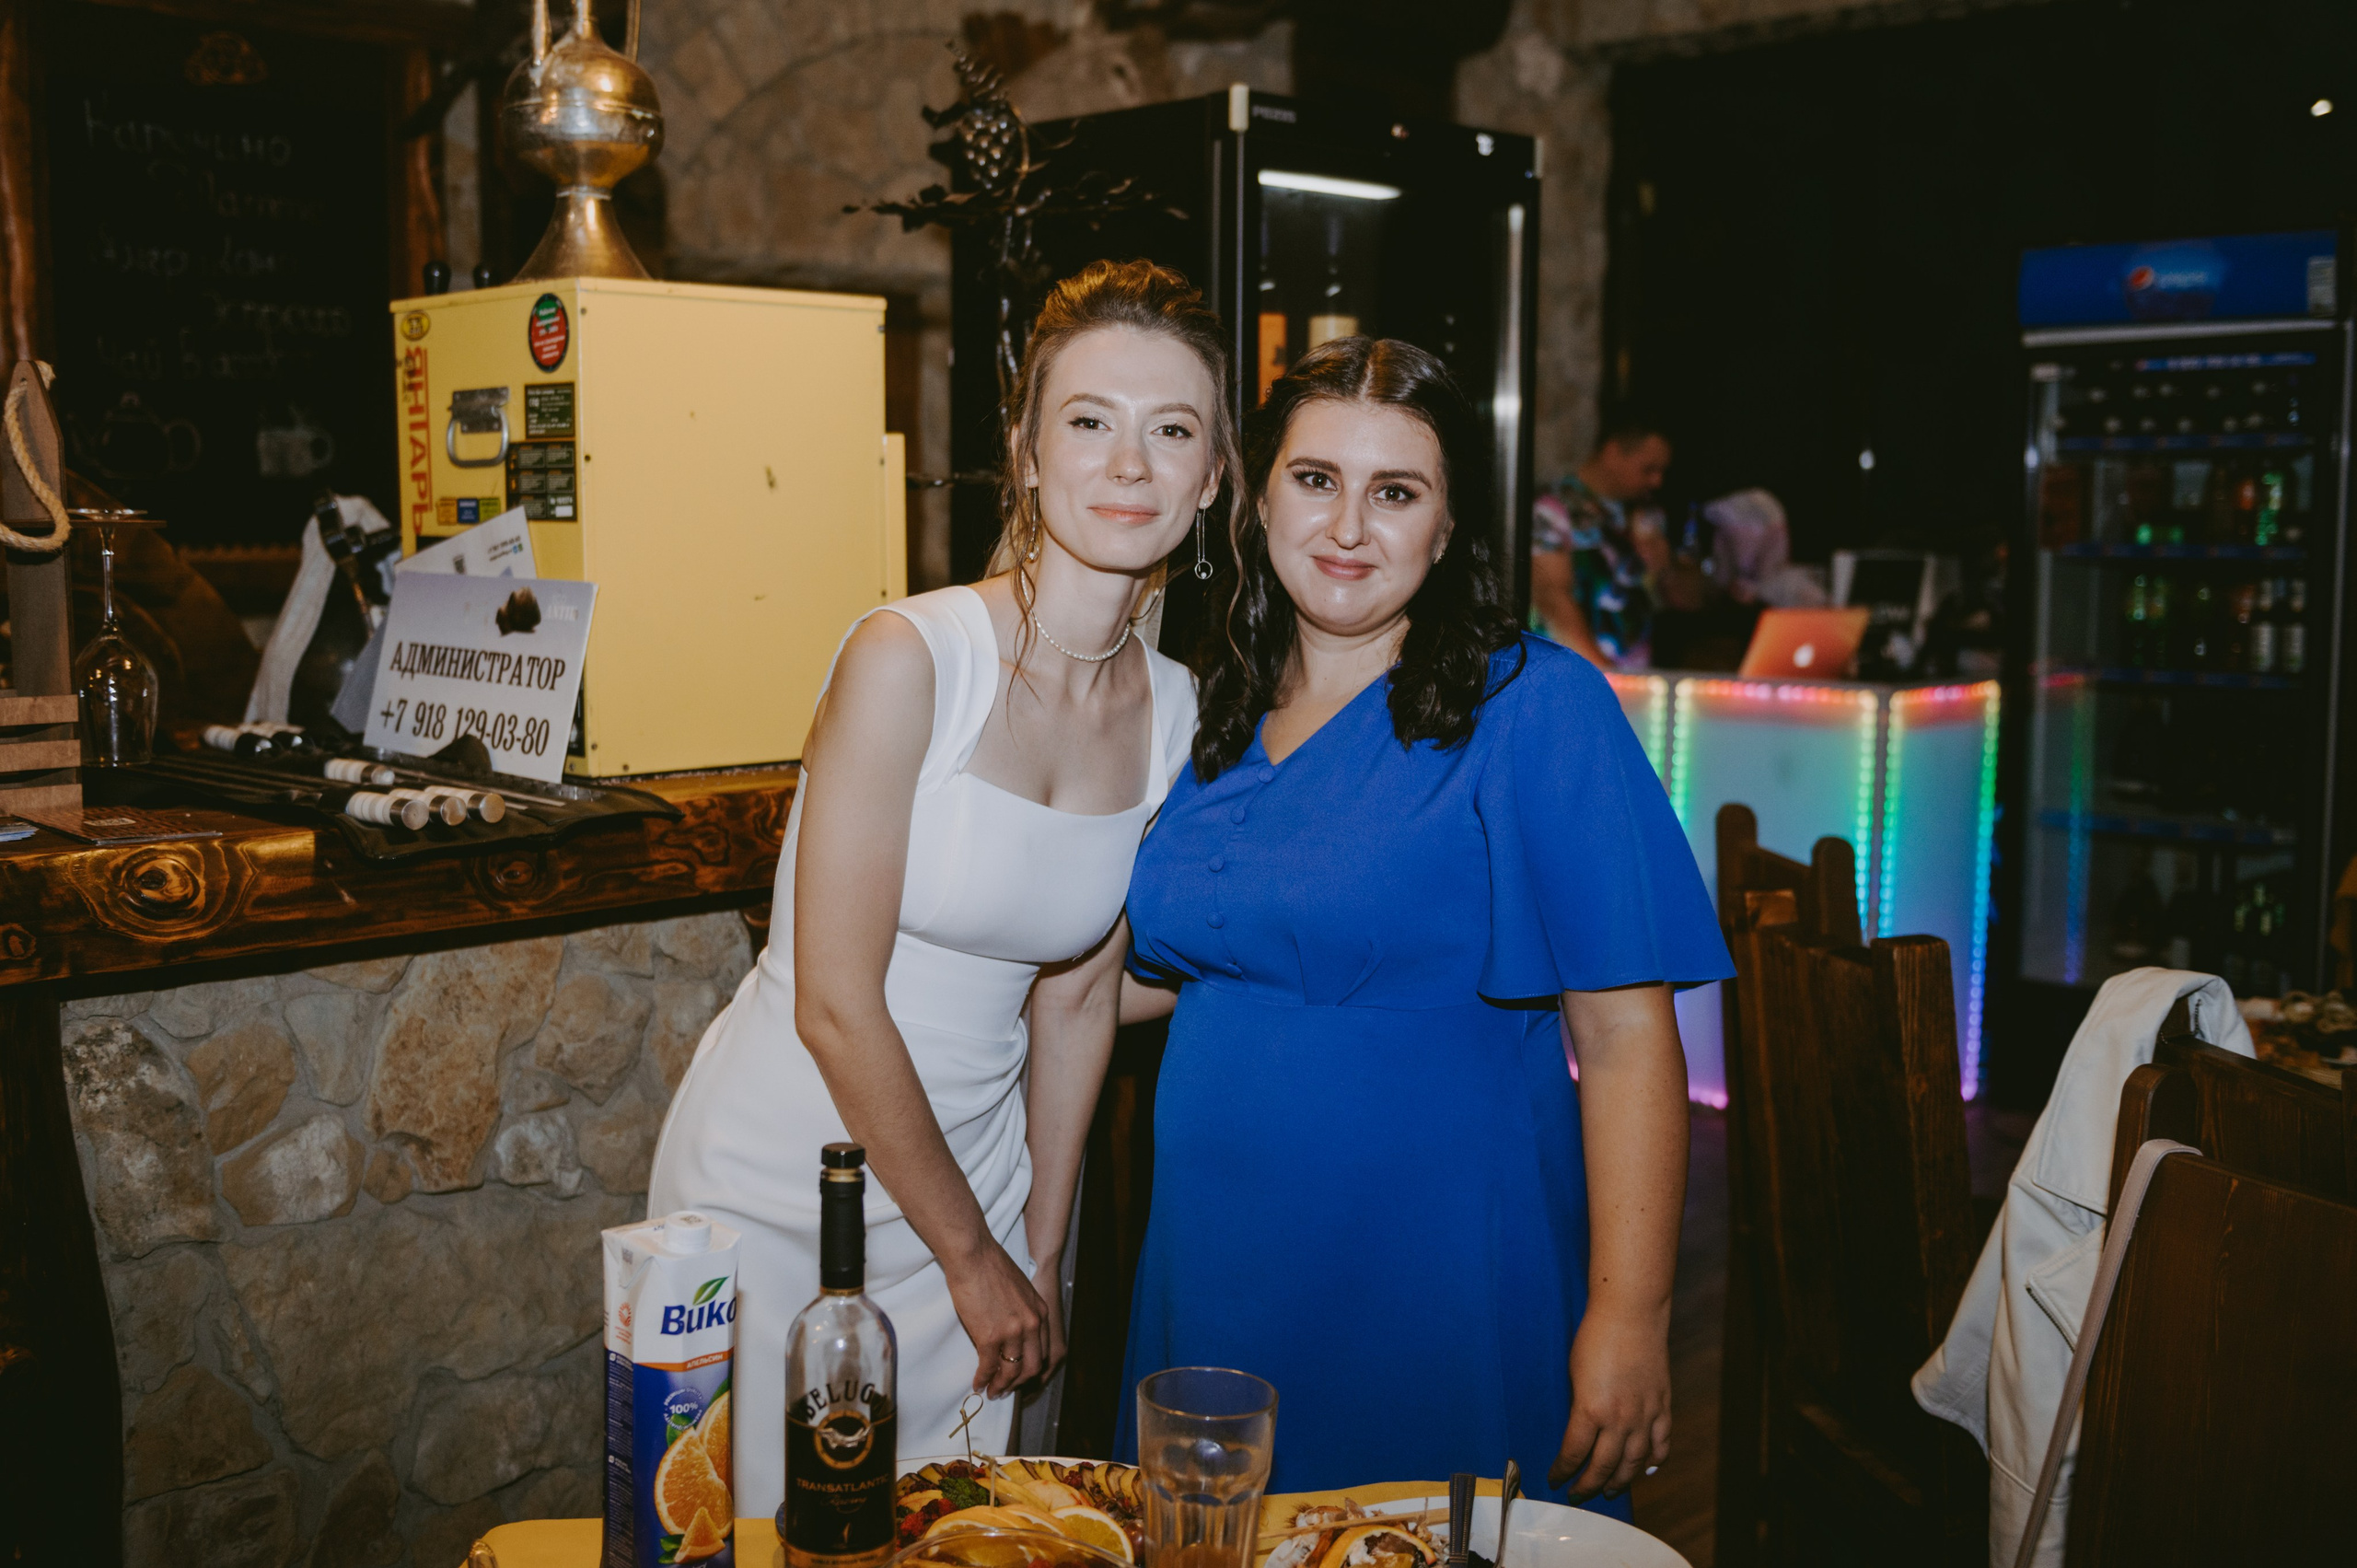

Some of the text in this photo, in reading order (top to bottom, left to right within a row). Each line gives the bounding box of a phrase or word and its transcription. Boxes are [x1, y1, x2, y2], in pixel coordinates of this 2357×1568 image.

[405, 345, 429, 536] ЯНТАРЬ
[389, 641, 566, 691] АДМИНИСТРАТОР
[380, 698, 550, 757] +7 918 129-03-80
[687, 1353, 724, 1369] АПЕЛЬСИН
[669, 1401, 699, 1414] 100%
